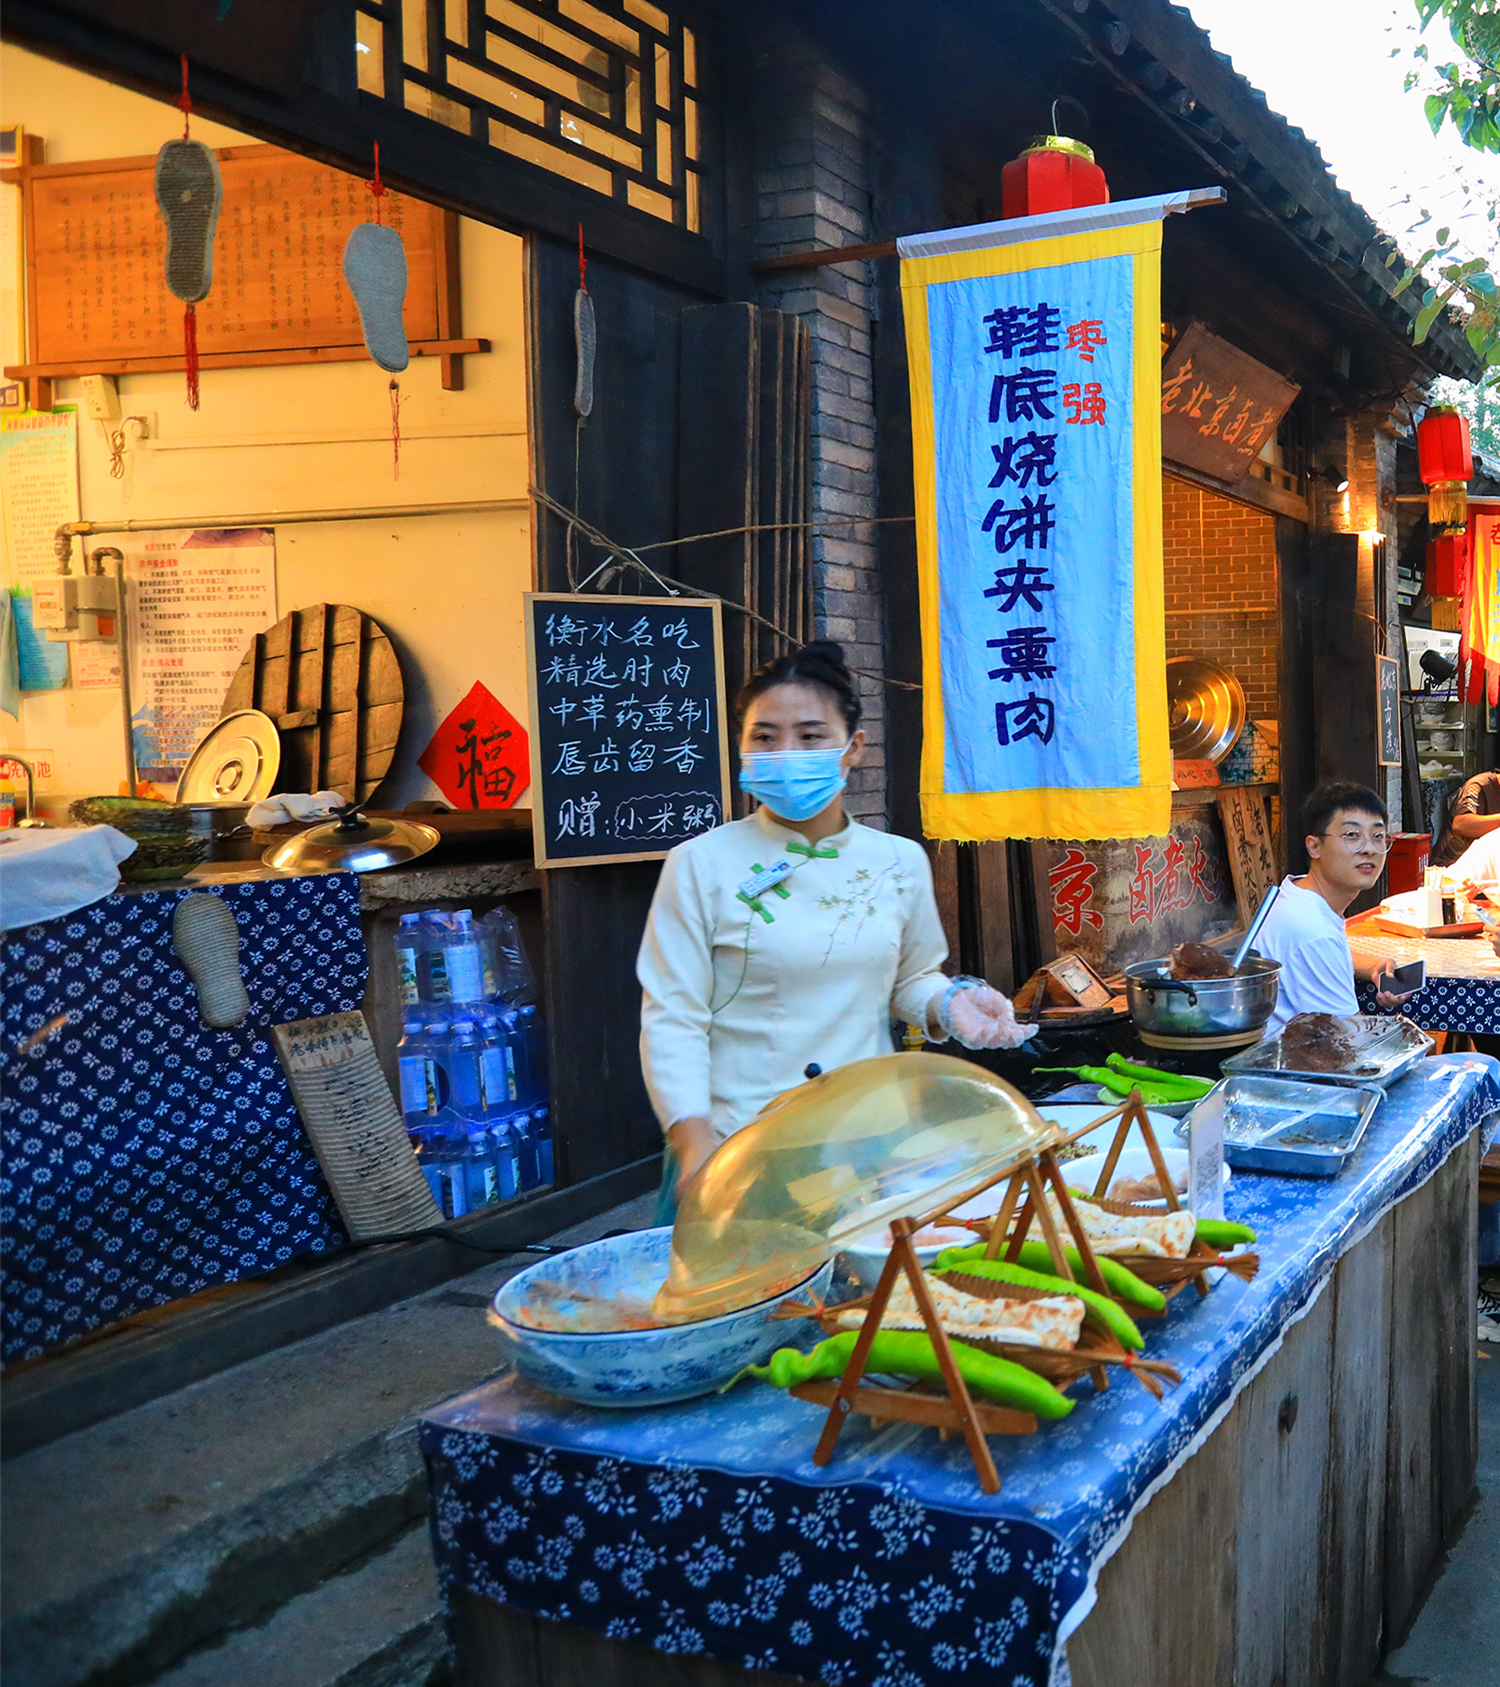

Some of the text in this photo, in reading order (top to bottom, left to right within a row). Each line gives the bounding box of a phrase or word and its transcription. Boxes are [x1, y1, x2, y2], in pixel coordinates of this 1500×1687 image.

[1062, 319, 1107, 426] 枣强
[982, 302, 1061, 747] 鞋底烧饼夹熏肉
[545, 612, 700, 649] 衡水名吃
[540, 652, 691, 689] 精选肘肉
[548, 693, 710, 733] 中草药熏制
[456, 718, 516, 809] 福
[551, 736, 705, 775] 唇齿留香
[1049, 835, 1222, 935] 京 卤煮火
